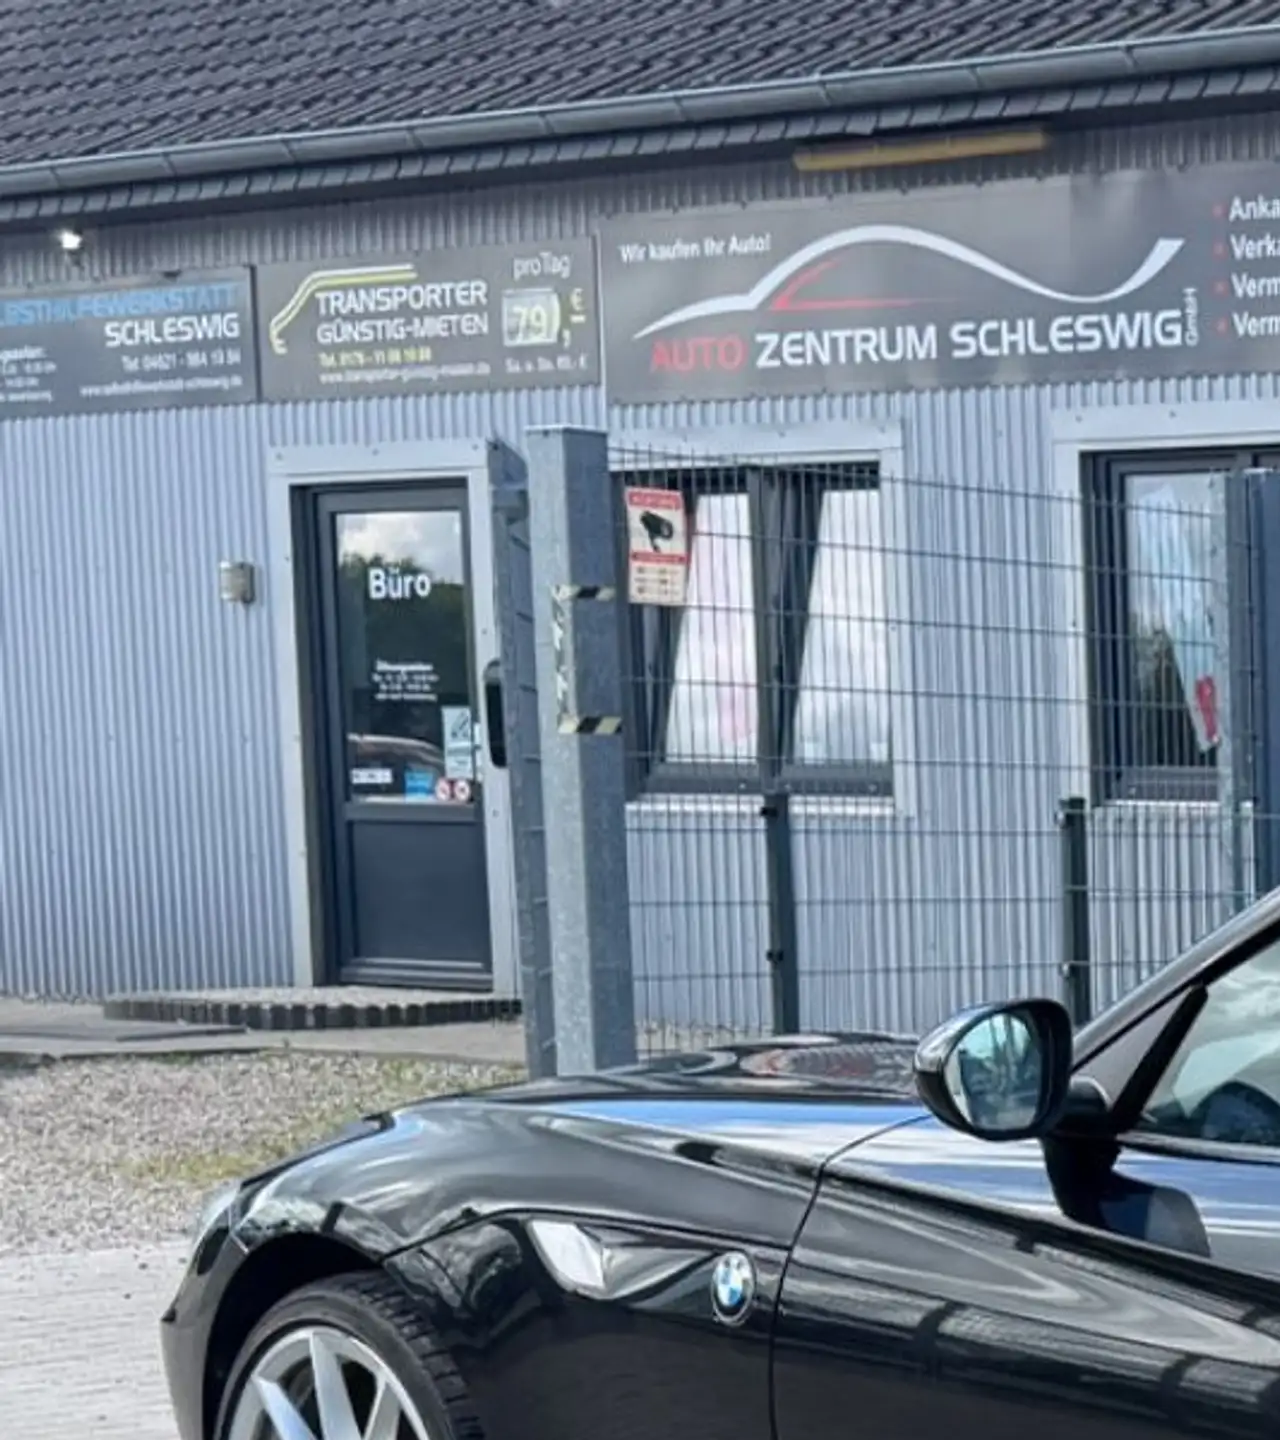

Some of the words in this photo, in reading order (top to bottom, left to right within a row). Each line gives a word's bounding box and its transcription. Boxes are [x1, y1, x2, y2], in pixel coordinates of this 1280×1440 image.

[315, 279, 489, 317] TRANSPORTER
[103, 312, 240, 348] SCHLESWIG
[316, 312, 489, 344] GÜNSTIG-MIETEN
[650, 334, 748, 374] AUTO
[755, 323, 938, 369] ZENTRUM
[949, 309, 1183, 358] SCHLESWIG
[368, 567, 431, 600] Büro
